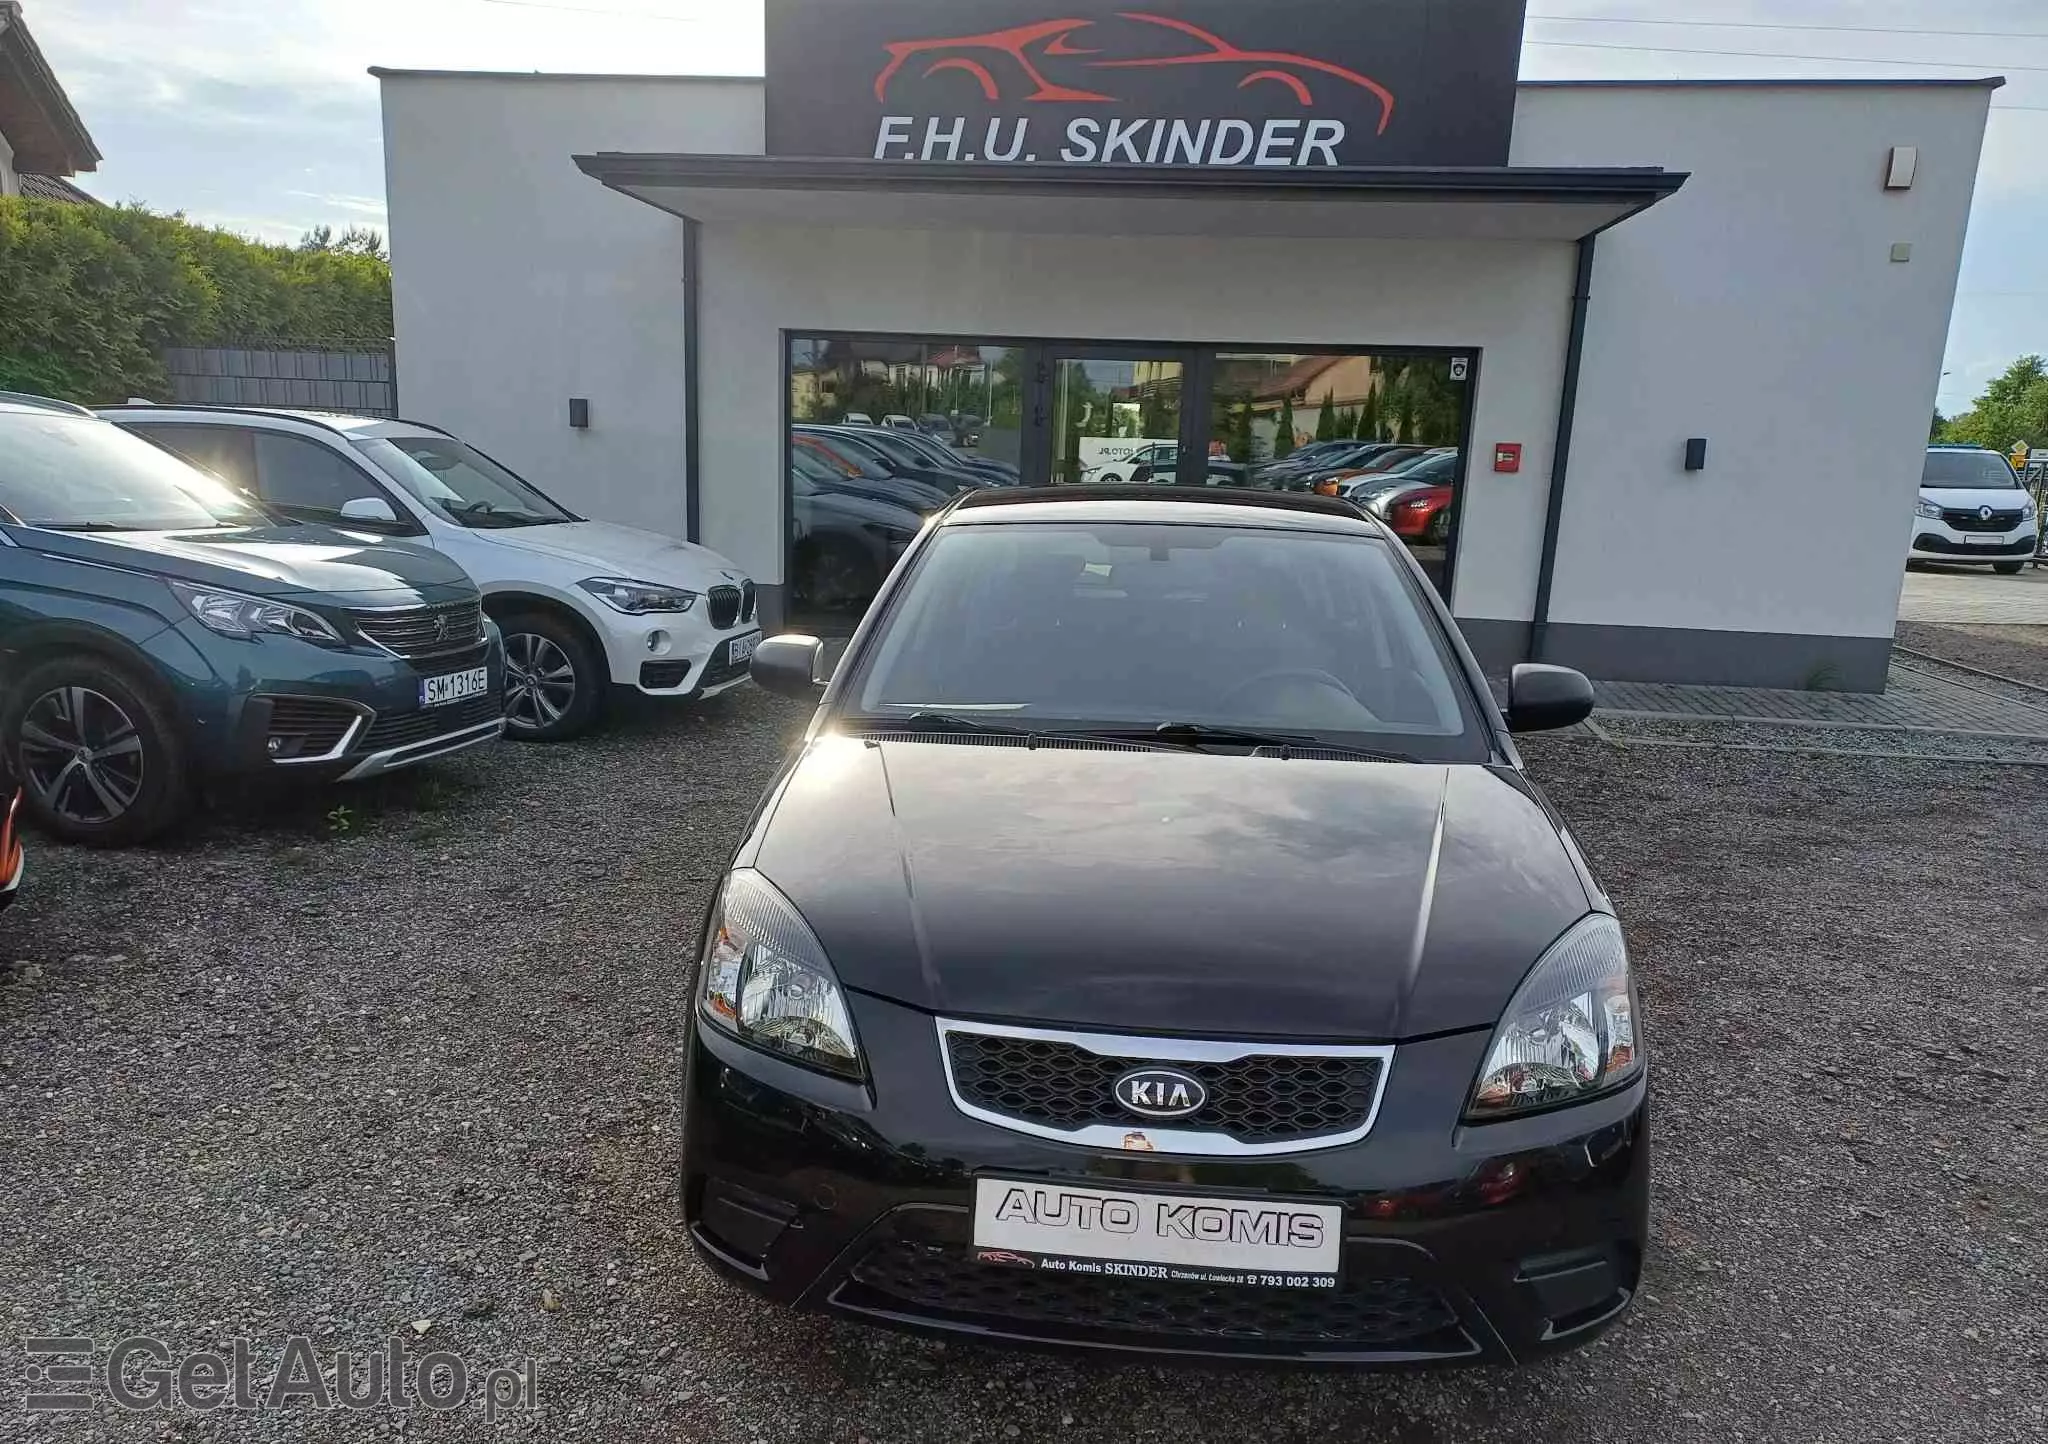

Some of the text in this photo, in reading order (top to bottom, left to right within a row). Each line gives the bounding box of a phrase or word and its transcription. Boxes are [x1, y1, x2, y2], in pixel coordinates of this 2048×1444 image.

[873, 116, 1345, 166] F.H.U. SKINDER
[1131, 1080, 1191, 1107] KIA
[996, 1188, 1323, 1249] AUTO KOMIS
[1041, 1258, 1066, 1270] Auto
[1068, 1260, 1102, 1273] Komis
[1105, 1262, 1168, 1279] SKINDER
[1260, 1275, 1282, 1286] 793
[1286, 1276, 1309, 1287] 002
[1312, 1277, 1335, 1288] 309
